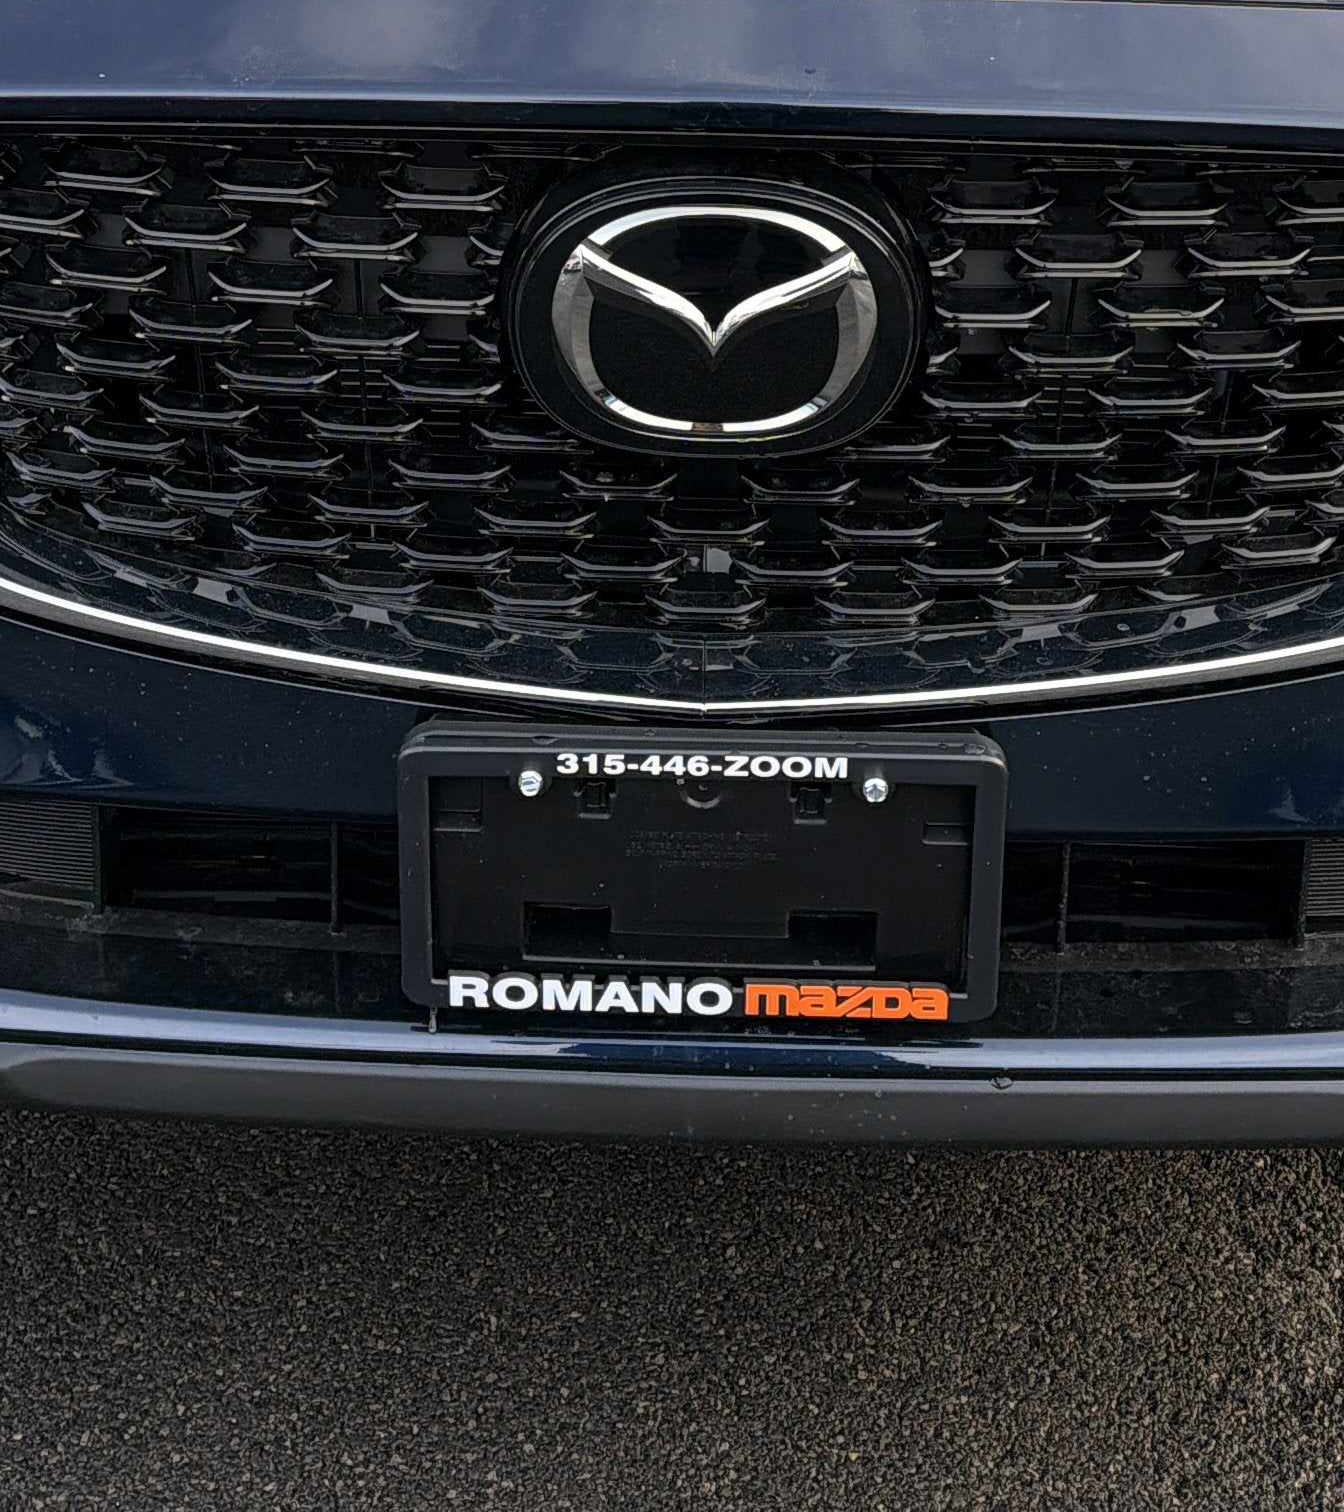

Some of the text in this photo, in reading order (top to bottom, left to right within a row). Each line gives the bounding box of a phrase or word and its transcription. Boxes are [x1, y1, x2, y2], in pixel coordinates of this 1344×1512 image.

[556, 753, 849, 780] 315-446-ZOOM
[449, 975, 949, 1020] ROMANO mazda
